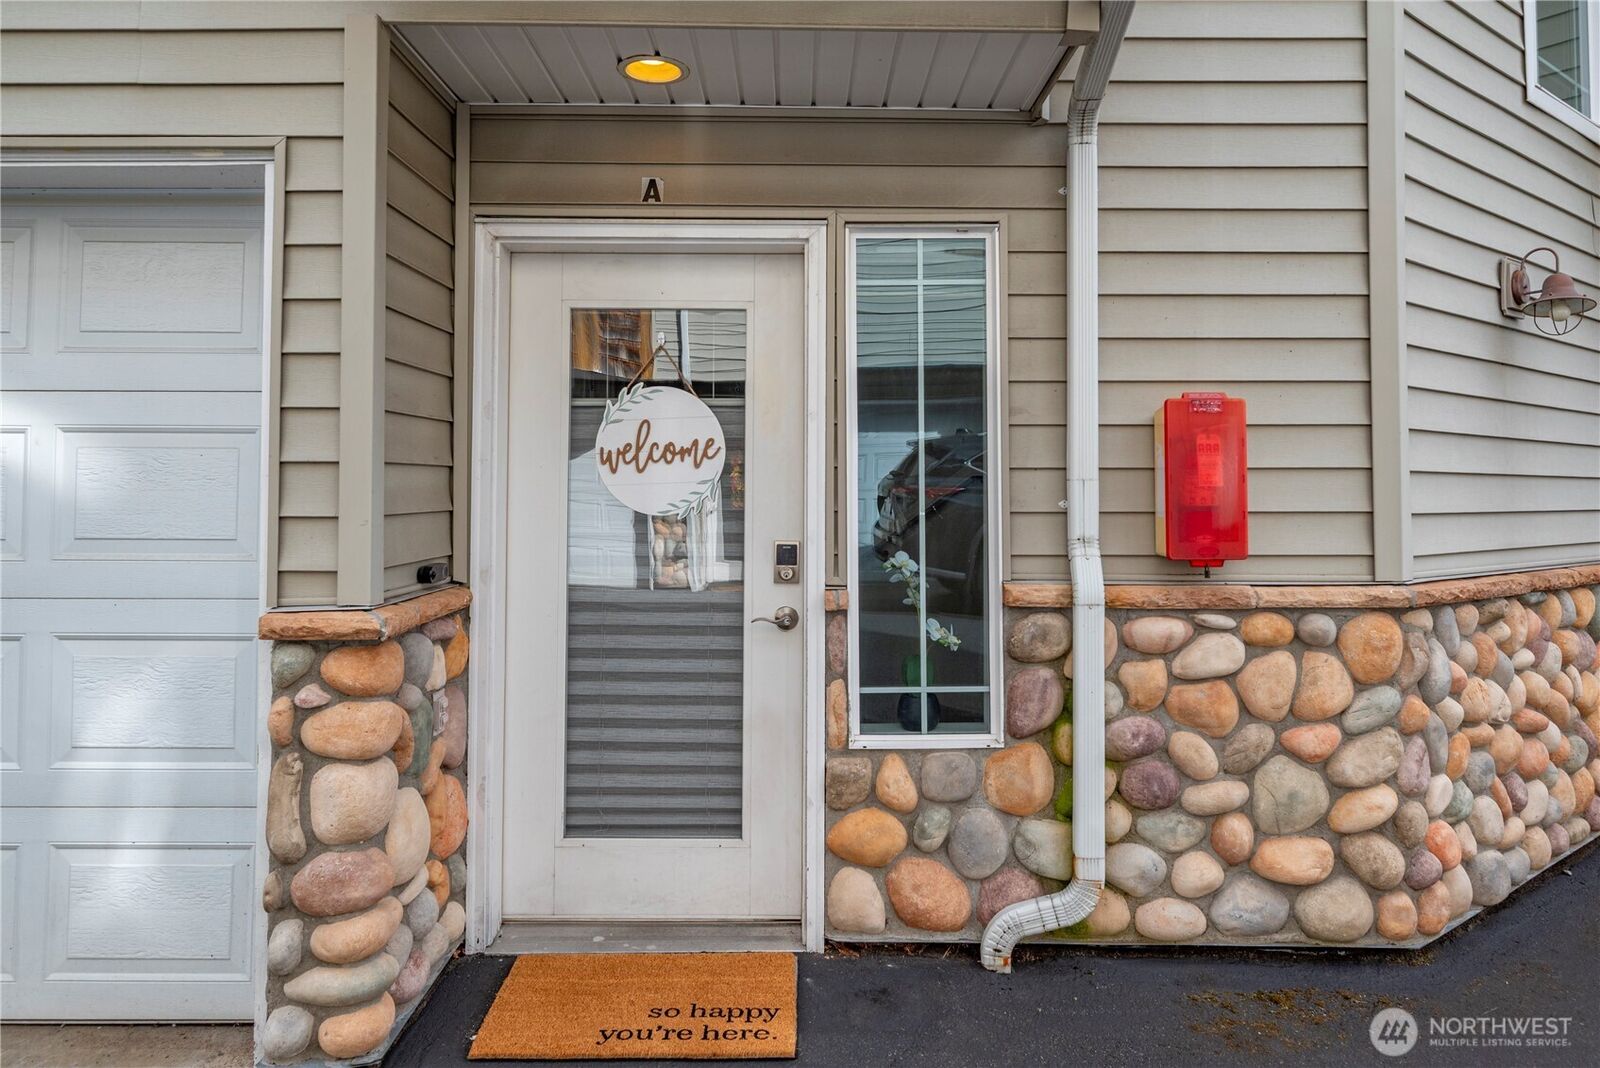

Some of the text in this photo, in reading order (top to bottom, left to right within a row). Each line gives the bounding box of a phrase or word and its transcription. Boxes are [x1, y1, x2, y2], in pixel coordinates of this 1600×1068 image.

[642, 178, 661, 202] A
[600, 419, 721, 474] welcome
[648, 1003, 780, 1023] so happy
[596, 1025, 778, 1045] you're here.
